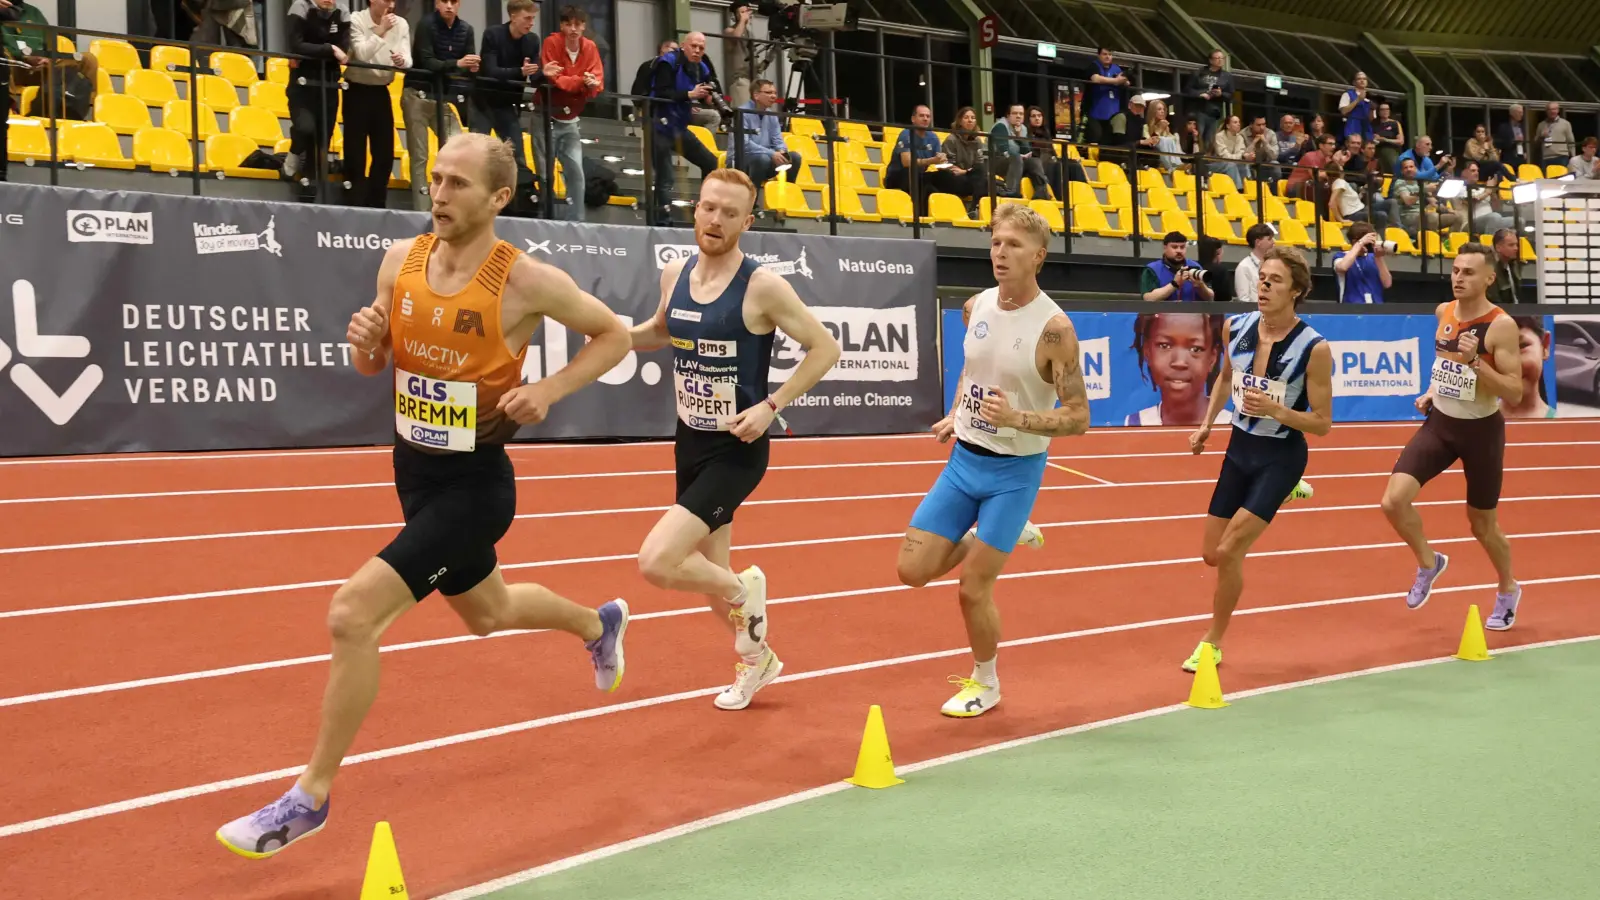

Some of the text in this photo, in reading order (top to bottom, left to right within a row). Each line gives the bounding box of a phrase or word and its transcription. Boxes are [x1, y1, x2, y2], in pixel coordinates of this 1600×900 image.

[983, 20, 994, 42] S
[105, 217, 148, 232] PLAN
[317, 231, 401, 250] NatuGe
[556, 243, 627, 256] XPENG
[838, 258, 914, 274] NatuGena
[123, 304, 311, 331] DEUTSCHER
[124, 341, 350, 366] LEICHTATHLET
[404, 338, 469, 367] VIACTIV
[699, 343, 727, 356] gmg
[680, 359, 738, 373] LAV Stadtwerke
[834, 360, 910, 370] TERNATIONAL
[1342, 351, 1412, 374] PLAN
[124, 378, 277, 403] VERBAND
[1344, 380, 1413, 388] INTERNATIONAL
[678, 390, 731, 416] RUPPERT
[833, 392, 861, 407] eine
[864, 392, 912, 407] Chance
[963, 393, 981, 415] FAR
[399, 393, 467, 427] BREMM
[698, 419, 716, 427] PLAN
[424, 431, 447, 441] PLAN
